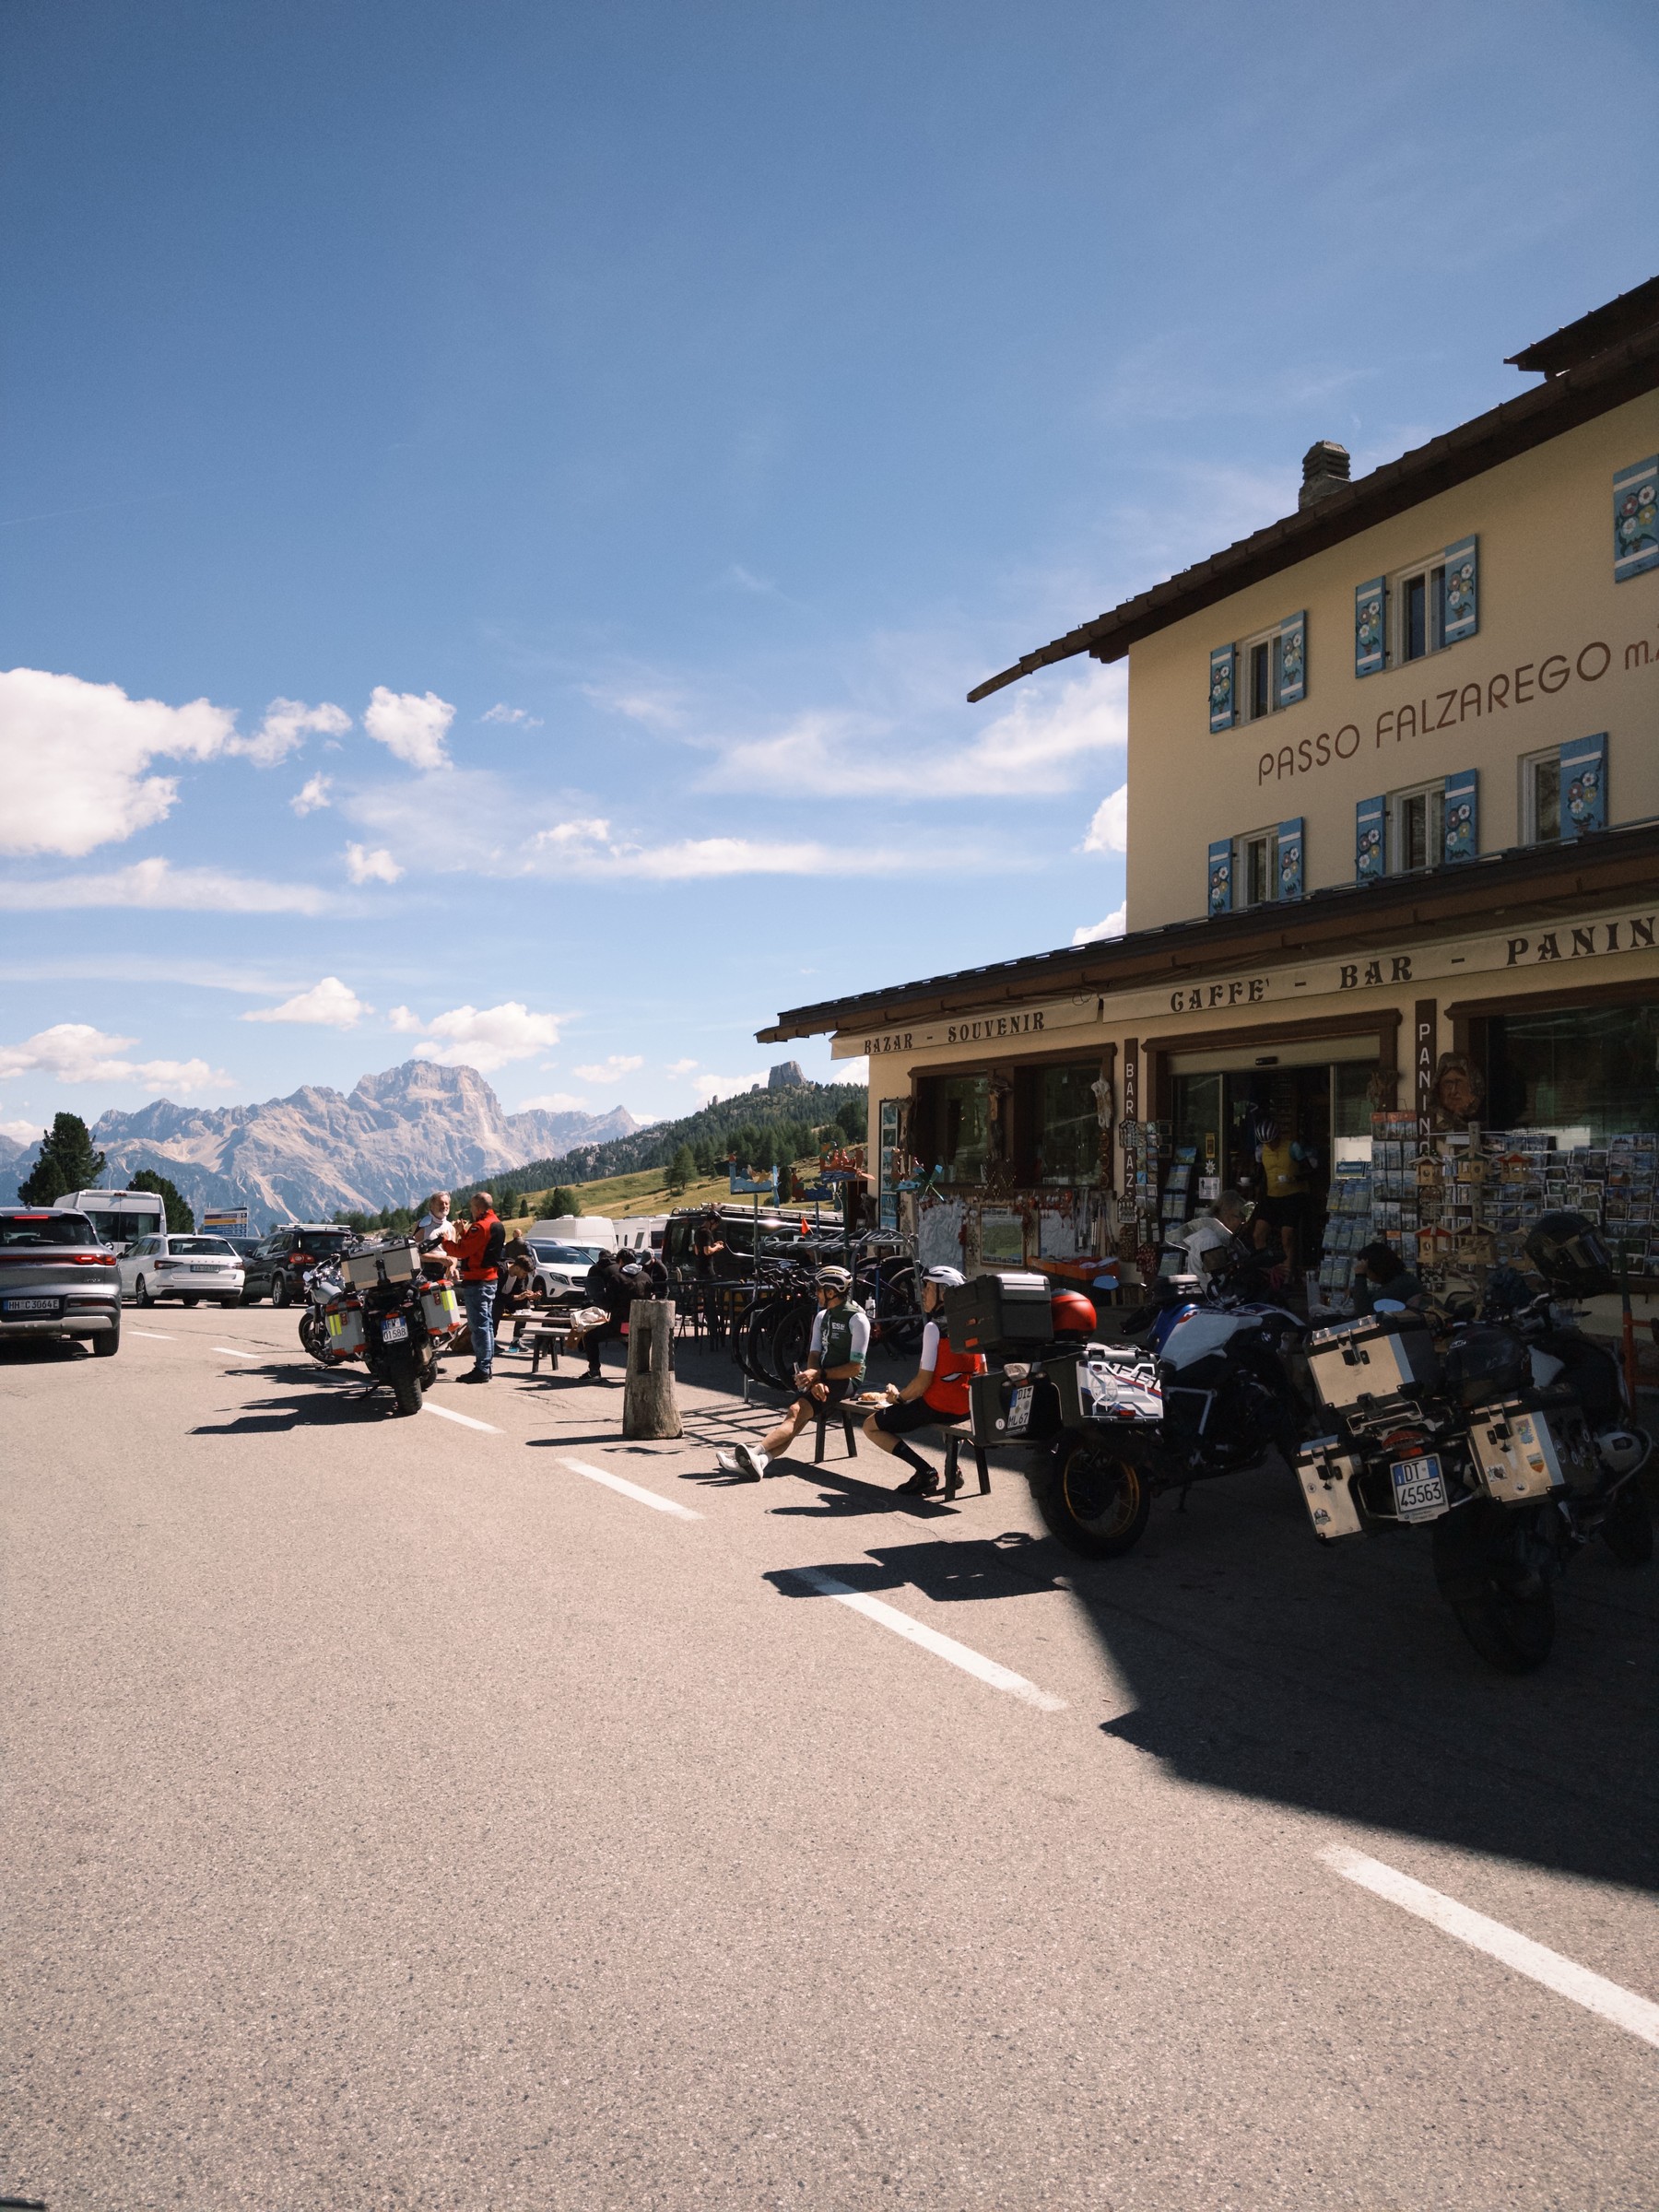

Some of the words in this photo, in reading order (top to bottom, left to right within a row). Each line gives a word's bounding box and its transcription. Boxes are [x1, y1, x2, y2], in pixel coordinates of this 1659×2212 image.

[1257, 724, 1360, 786] PASSO
[1376, 641, 1611, 748] FALZAREGO
[1339, 955, 1413, 990] BAR
[1506, 915, 1656, 966] PANIN
[864, 1032, 913, 1055] BAZAR
[947, 1010, 1045, 1042] SOUVENIR
[1125, 1063, 1135, 1114] BAR
[8, 1300, 20, 1310] HH
[1018, 1387, 1032, 1400] DIZ
[1018, 1412, 1029, 1424] 67
[1404, 1462, 1419, 1482] DT
[1401, 1481, 1441, 1506] 45563
